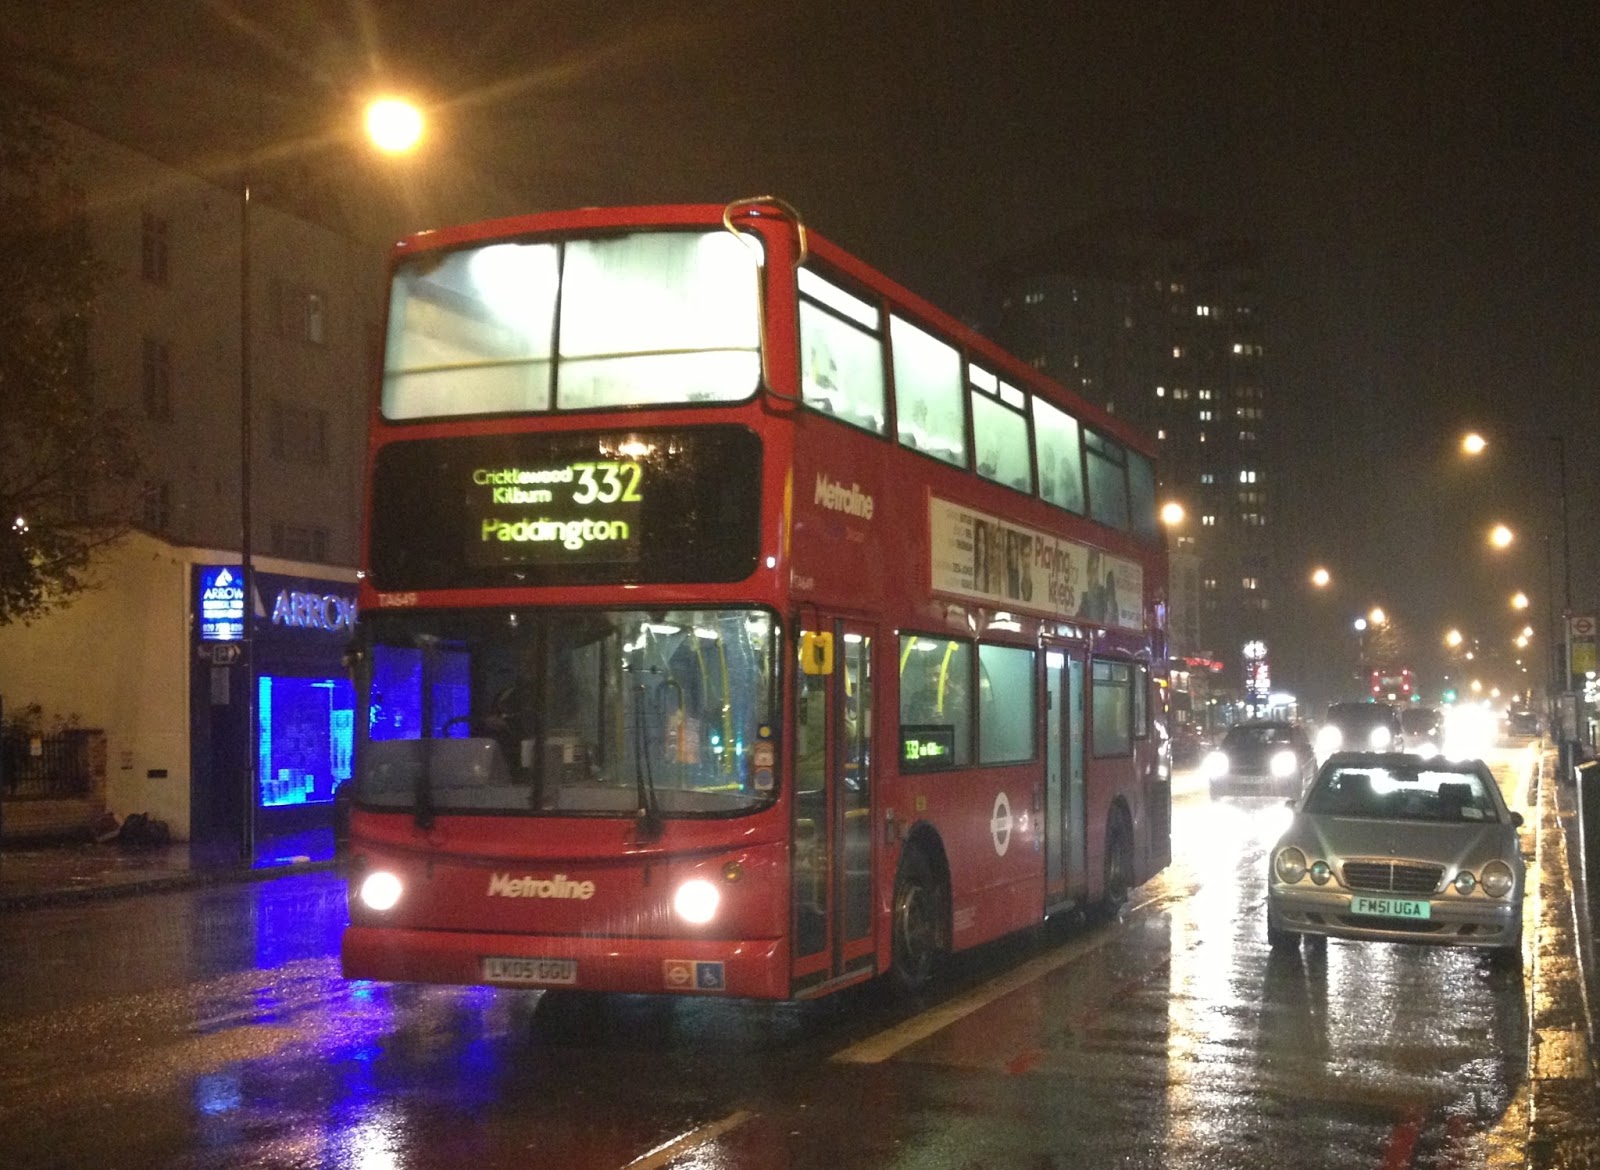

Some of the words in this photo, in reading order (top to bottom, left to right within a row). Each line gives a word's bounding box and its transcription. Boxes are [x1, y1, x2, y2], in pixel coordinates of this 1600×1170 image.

[473, 465, 574, 485] Cricklewood
[573, 462, 643, 504] 332
[493, 487, 552, 504] Kilburn
[814, 472, 874, 520] Metroline
[481, 516, 630, 550] Paddington
[1034, 535, 1070, 583] Playing
[203, 587, 244, 600] ARROW
[487, 873, 596, 901] Metroline
[1358, 899, 1390, 914] FM51
[1394, 902, 1421, 916] UGA
